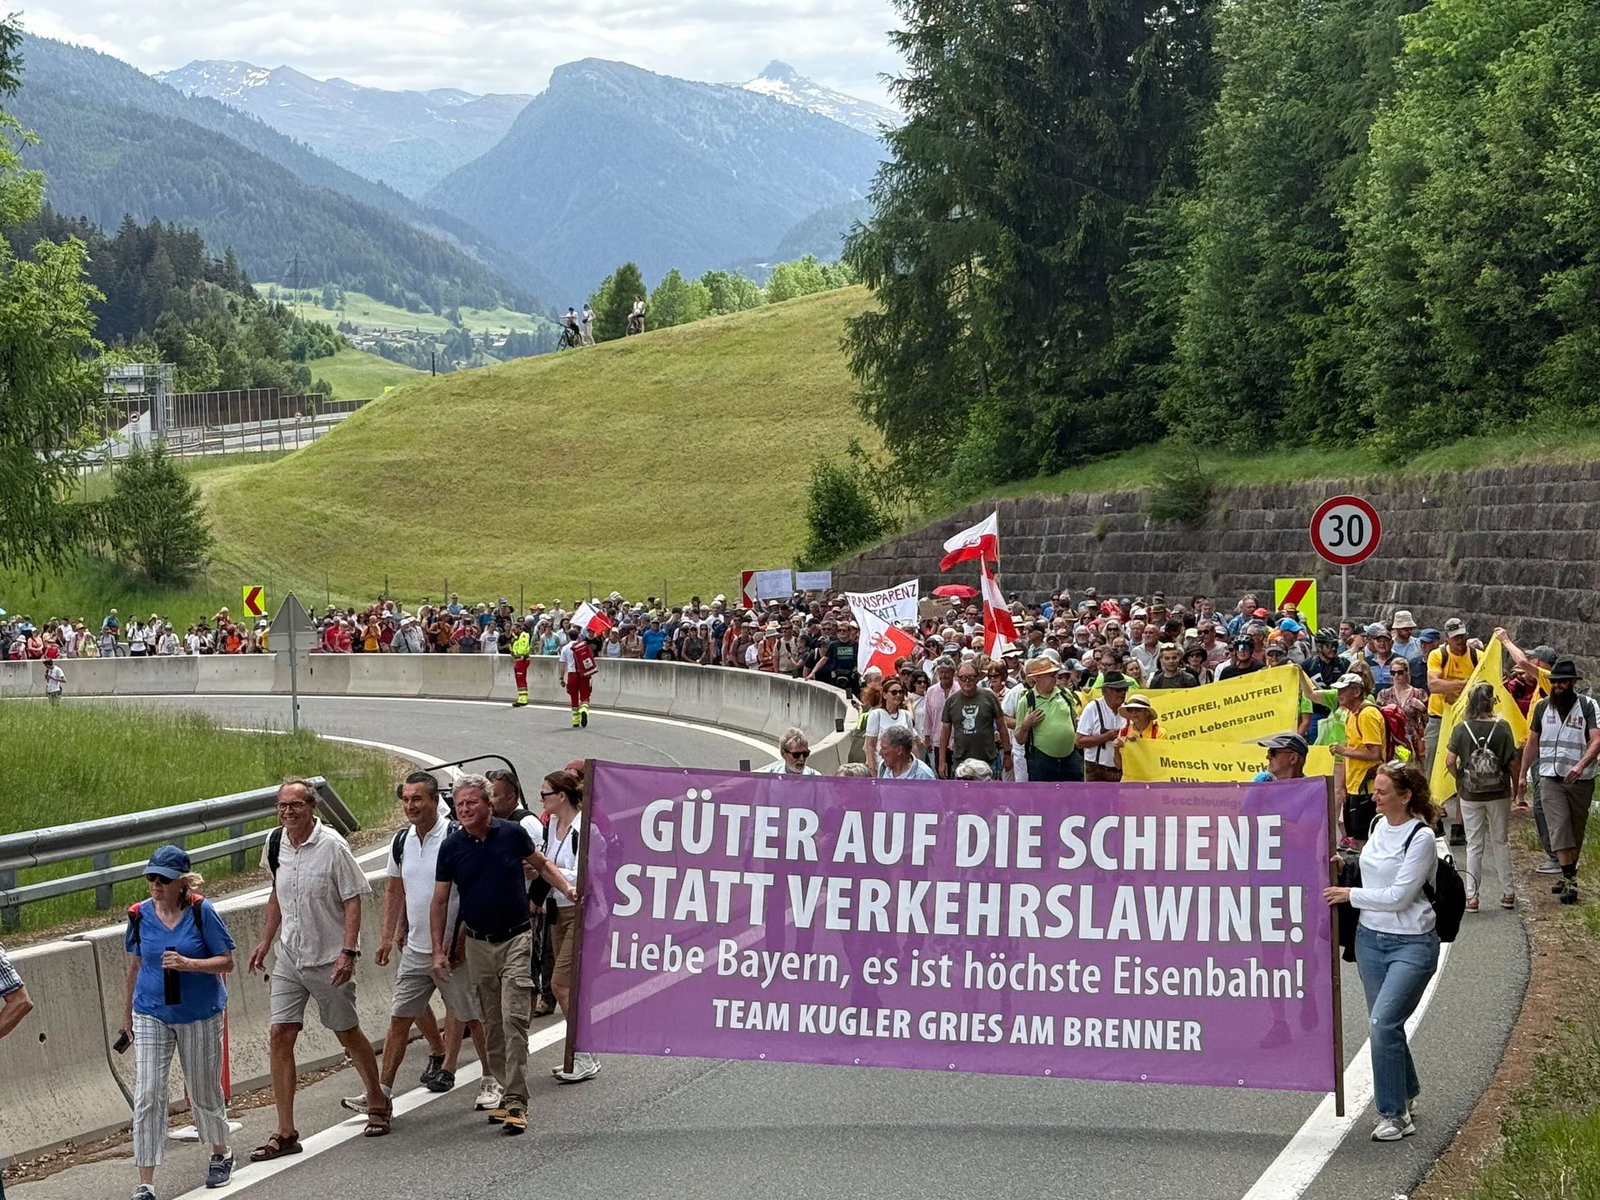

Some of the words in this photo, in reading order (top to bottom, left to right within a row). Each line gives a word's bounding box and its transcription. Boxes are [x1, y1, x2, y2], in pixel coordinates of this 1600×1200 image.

[1328, 514, 1364, 547] 30
[846, 584, 917, 608] TRANSPARENZ
[871, 604, 898, 619] TATT
[1160, 701, 1221, 722] STAUFREI,
[1223, 684, 1283, 706] MAUTFREI
[1168, 729, 1197, 741] eren
[1199, 709, 1275, 734] Lebensraum
[1160, 757, 1209, 770] Mensch
[1213, 762, 1233, 771] vor
[1236, 761, 1268, 772] Verk
[1161, 795, 1242, 810] Beschleunig
[640, 788, 820, 861] GÜTER
[832, 810, 939, 866] AUF
[955, 814, 1043, 869] DIE
[1058, 814, 1282, 871] SCHIENE
[612, 863, 775, 926] STATT
[787, 874, 1304, 943] VERKEHRSLAWINE!
[610, 931, 705, 974] Liebe
[717, 938, 850, 989] Bayern,
[862, 955, 899, 985] es
[910, 949, 953, 988] ist
[963, 951, 1101, 994] höchste
[1113, 956, 1304, 999] Eisenbahn!
[713, 998, 790, 1032] TEAM
[798, 1004, 911, 1039] KUGLER
[918, 1011, 1003, 1043] GRIES
[1009, 1014, 1055, 1046] AM
[1063, 1016, 1202, 1051] BRENNER
